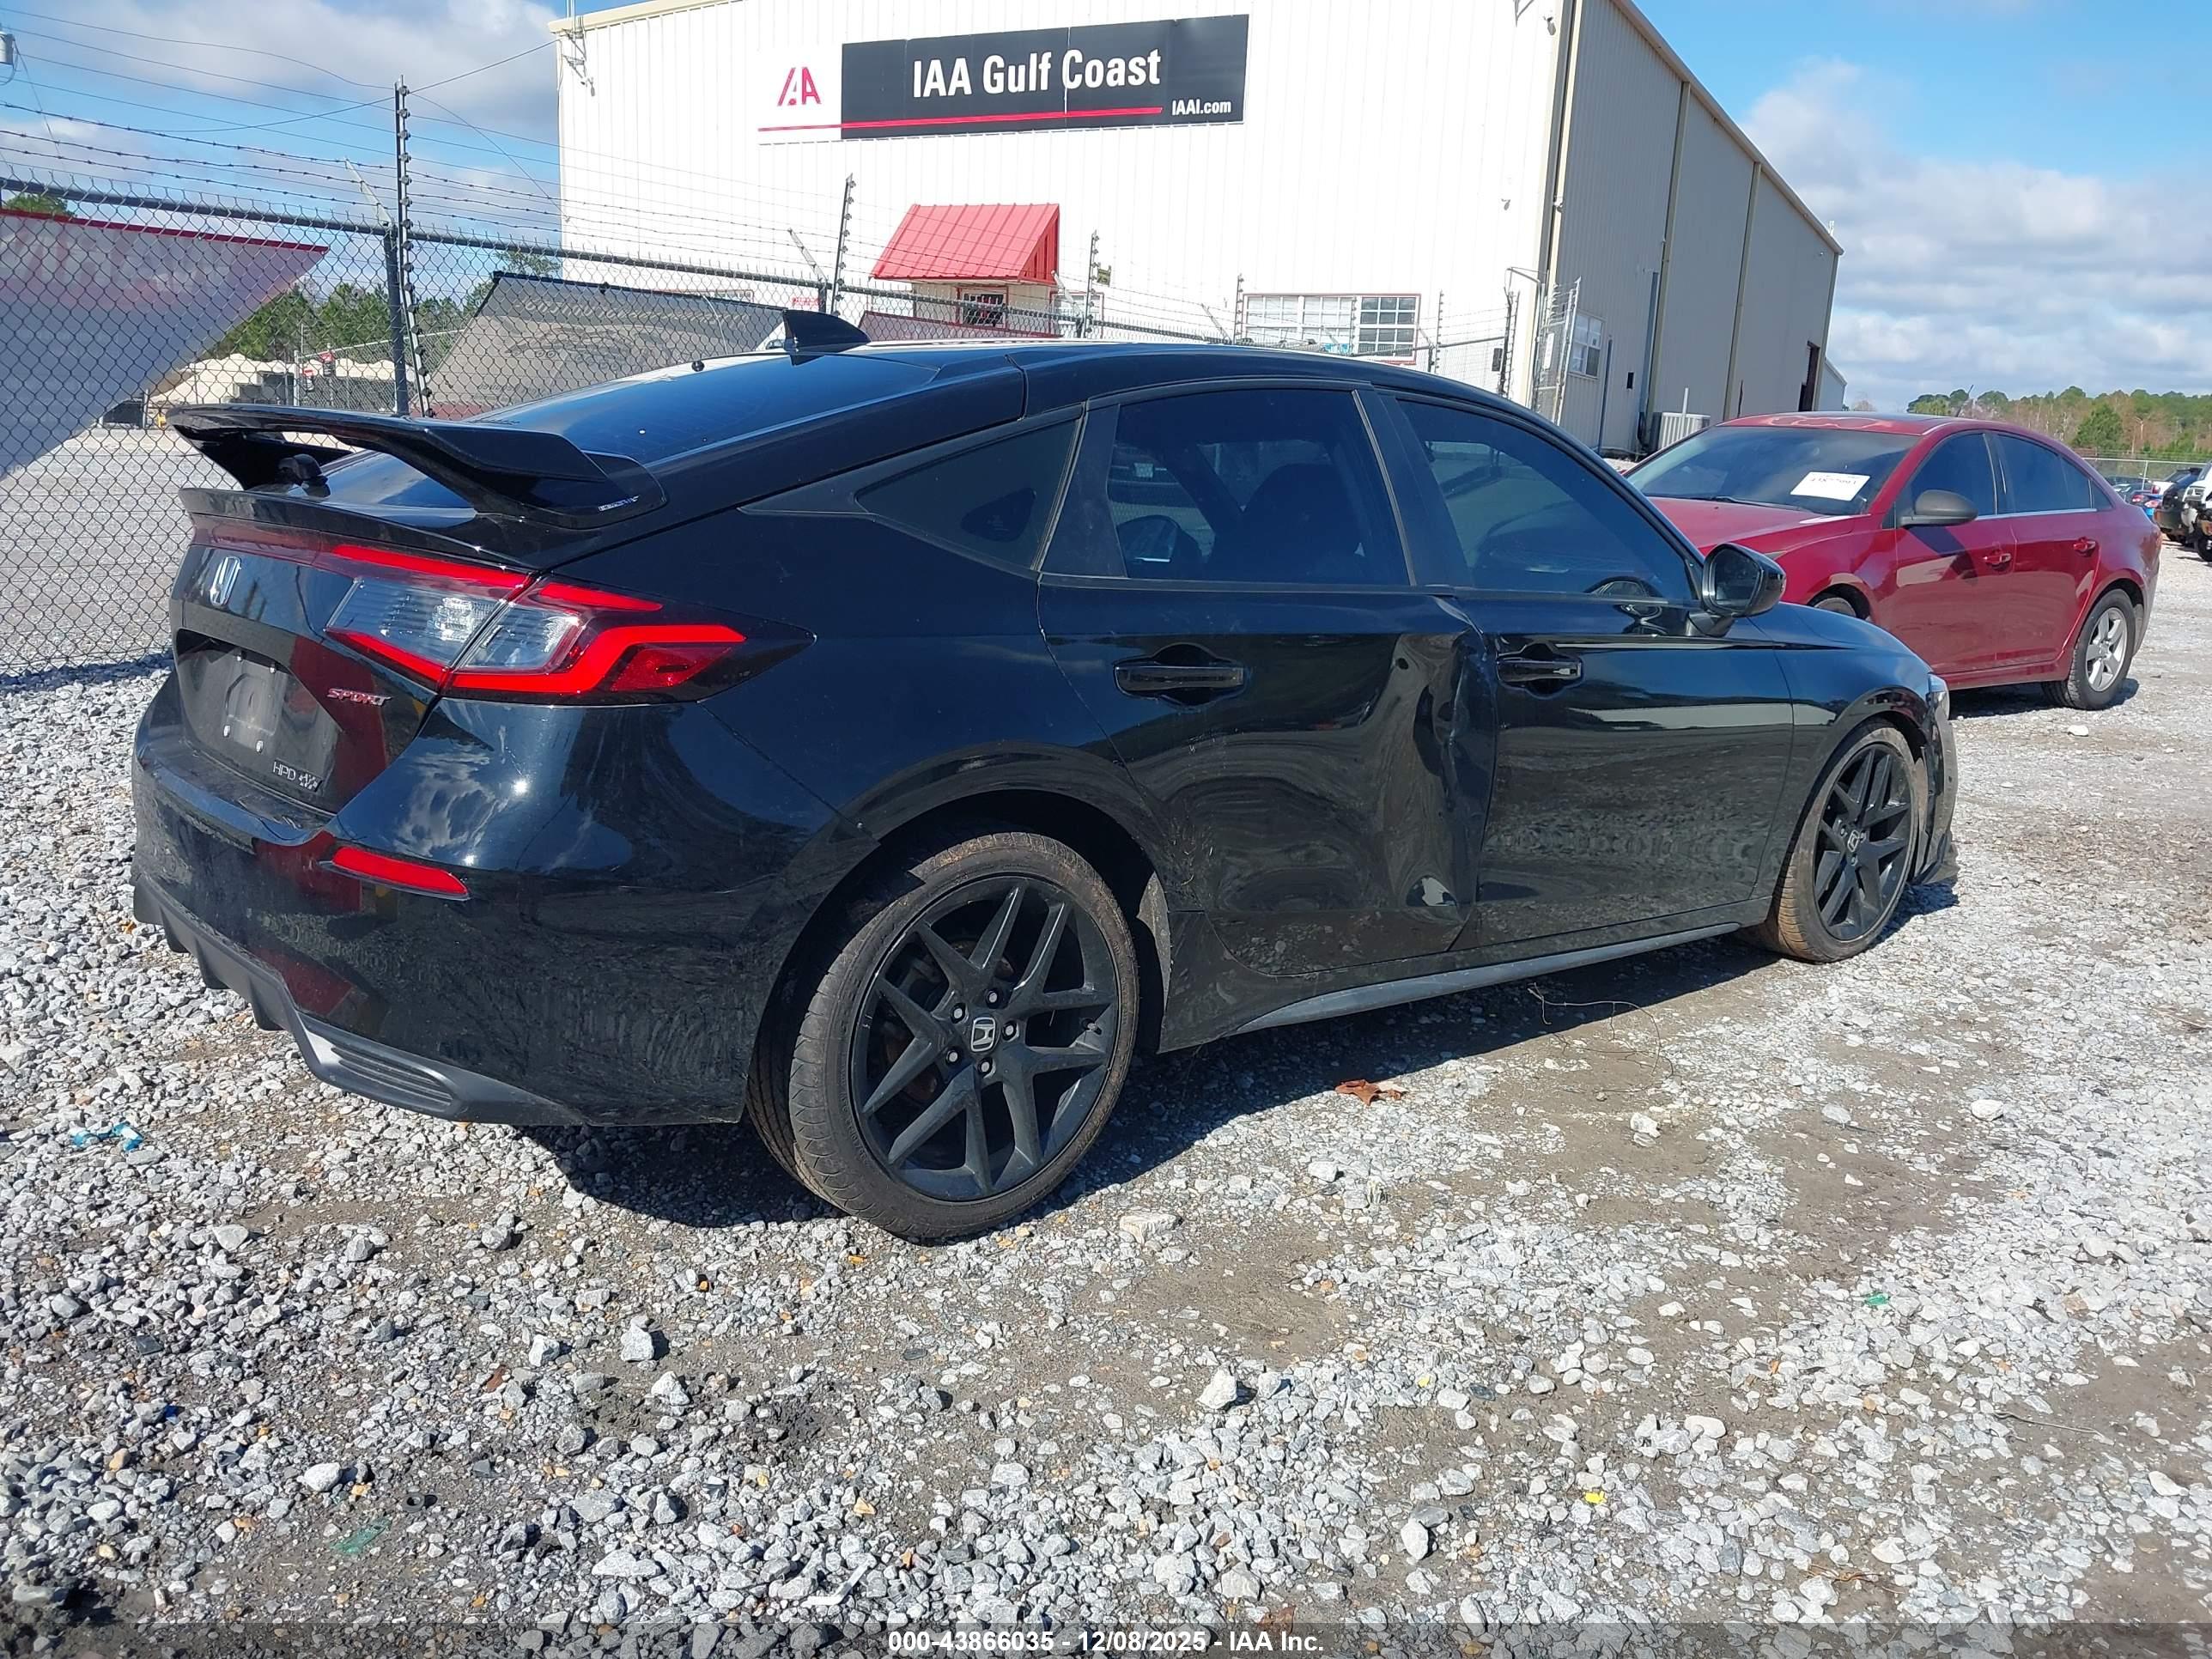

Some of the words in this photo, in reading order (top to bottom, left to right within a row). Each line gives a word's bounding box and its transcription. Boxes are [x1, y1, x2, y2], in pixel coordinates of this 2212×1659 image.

[914, 57, 972, 98] IAA
[982, 52, 1052, 94] Gulf
[1062, 47, 1161, 90] Coast
[1171, 98, 1231, 116] IAAI.com
[326, 688, 392, 706] SPORT
[272, 761, 296, 781] HPD
